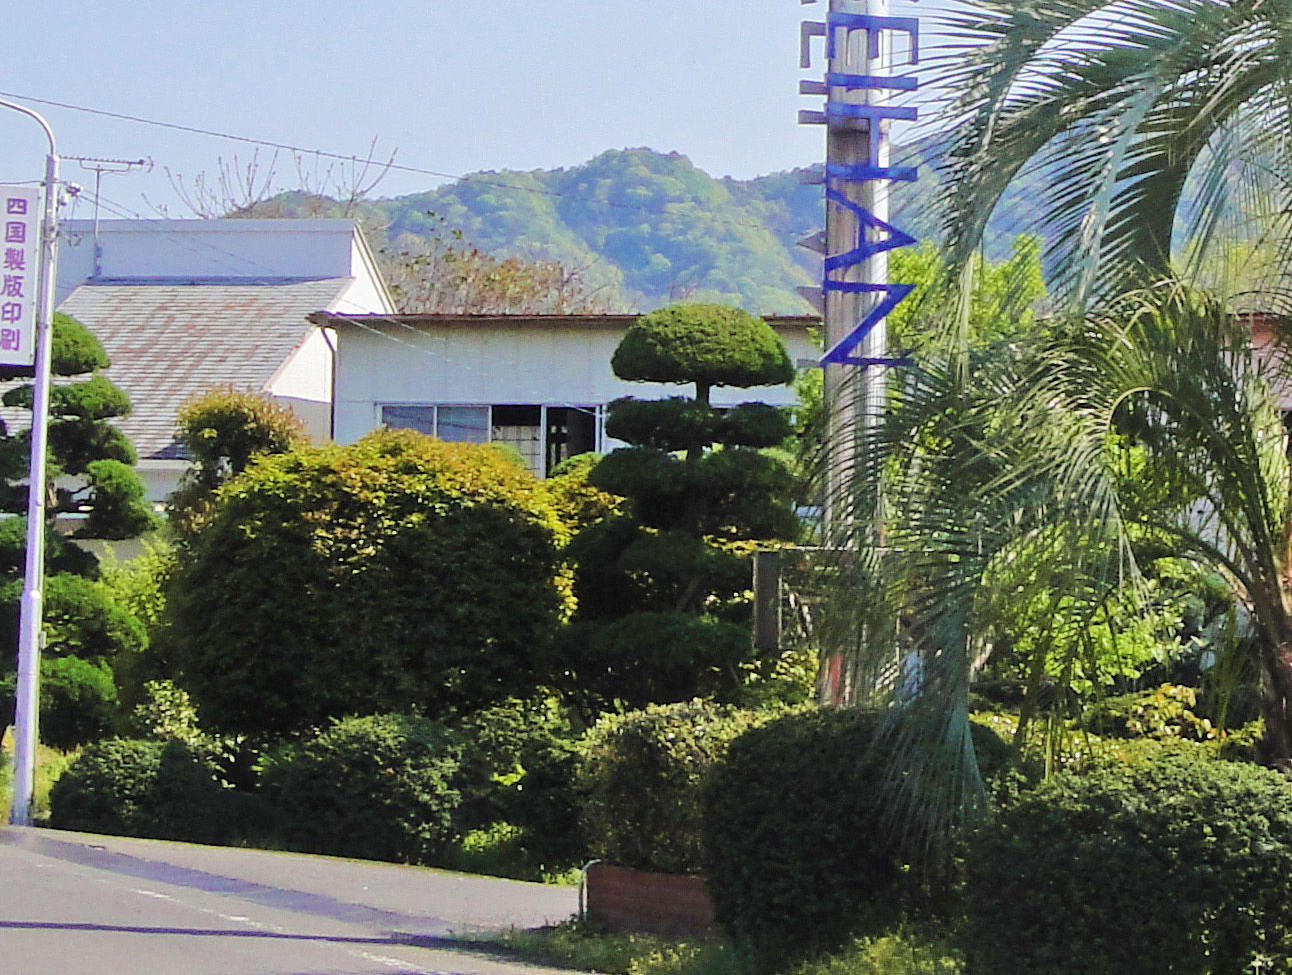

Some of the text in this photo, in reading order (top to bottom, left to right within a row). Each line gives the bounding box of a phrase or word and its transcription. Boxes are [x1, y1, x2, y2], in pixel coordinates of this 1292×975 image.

[0, 198, 28, 351] 四国製版印刷
